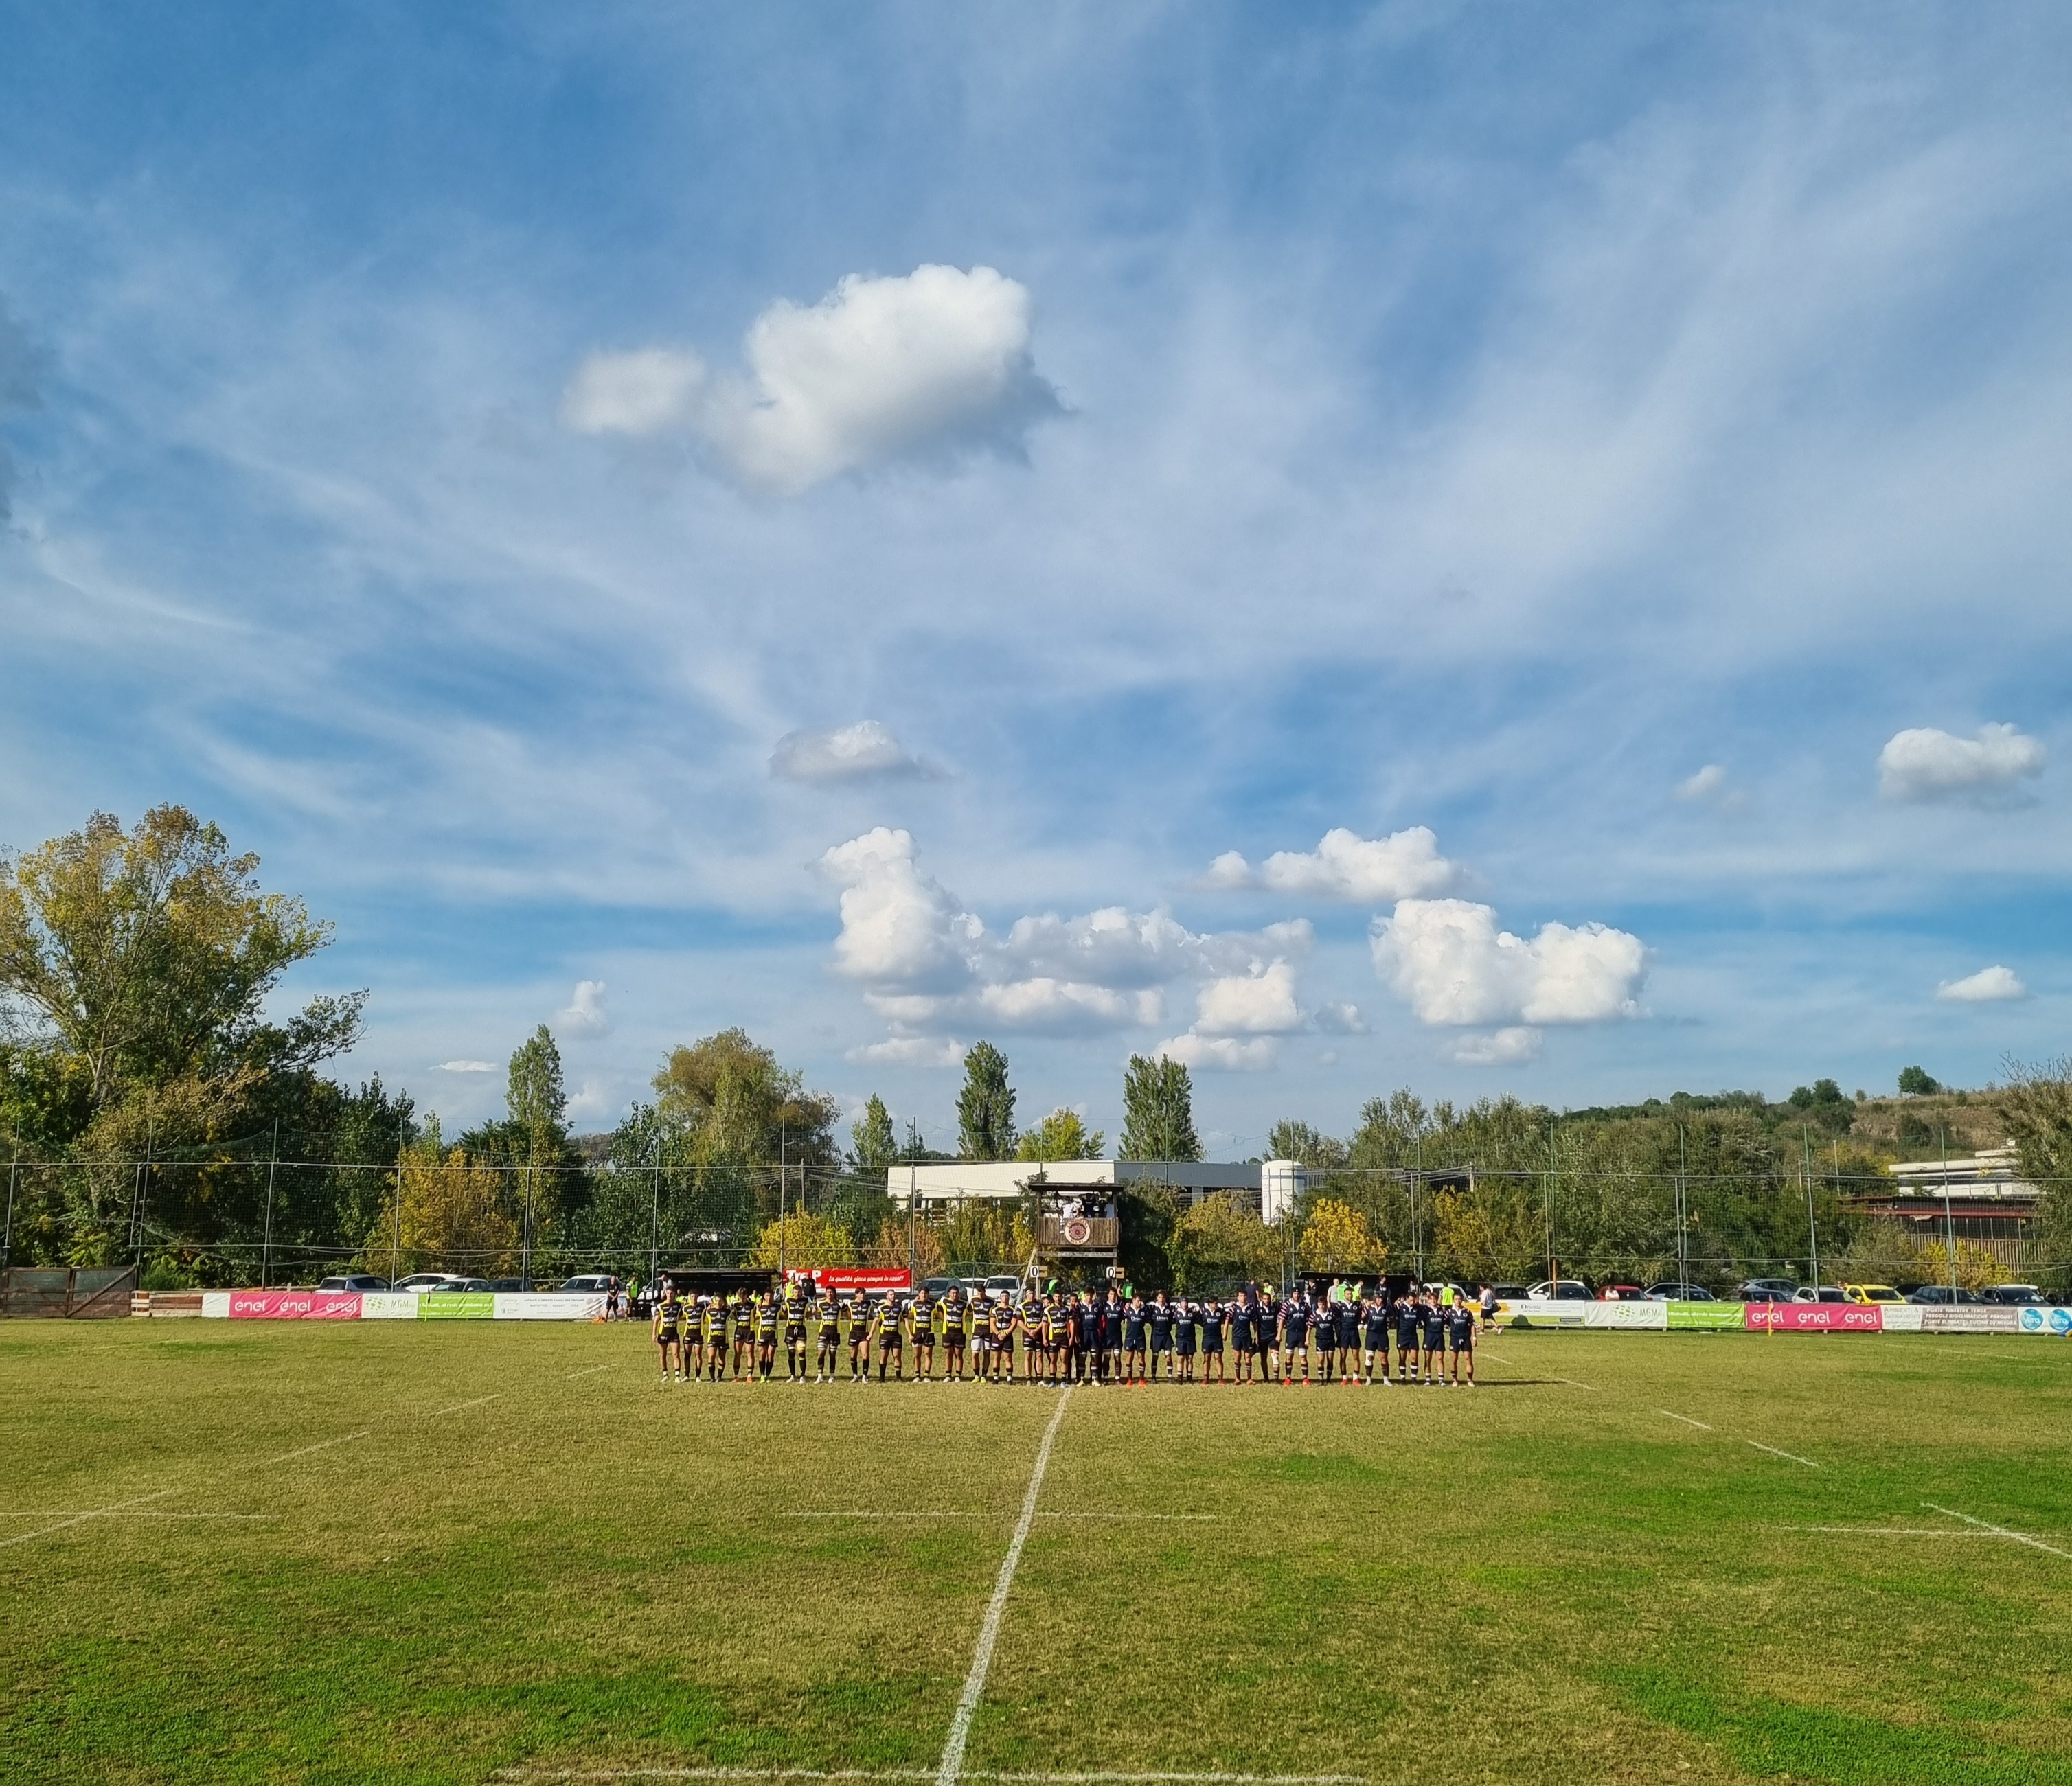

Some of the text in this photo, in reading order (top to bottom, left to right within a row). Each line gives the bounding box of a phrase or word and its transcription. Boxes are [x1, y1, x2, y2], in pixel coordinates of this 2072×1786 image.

[234, 1299, 358, 1312] enel enel enel
[1751, 1310, 1784, 1323] enel
[1798, 1310, 1830, 1323] enel
[1845, 1311, 1878, 1323] enel
